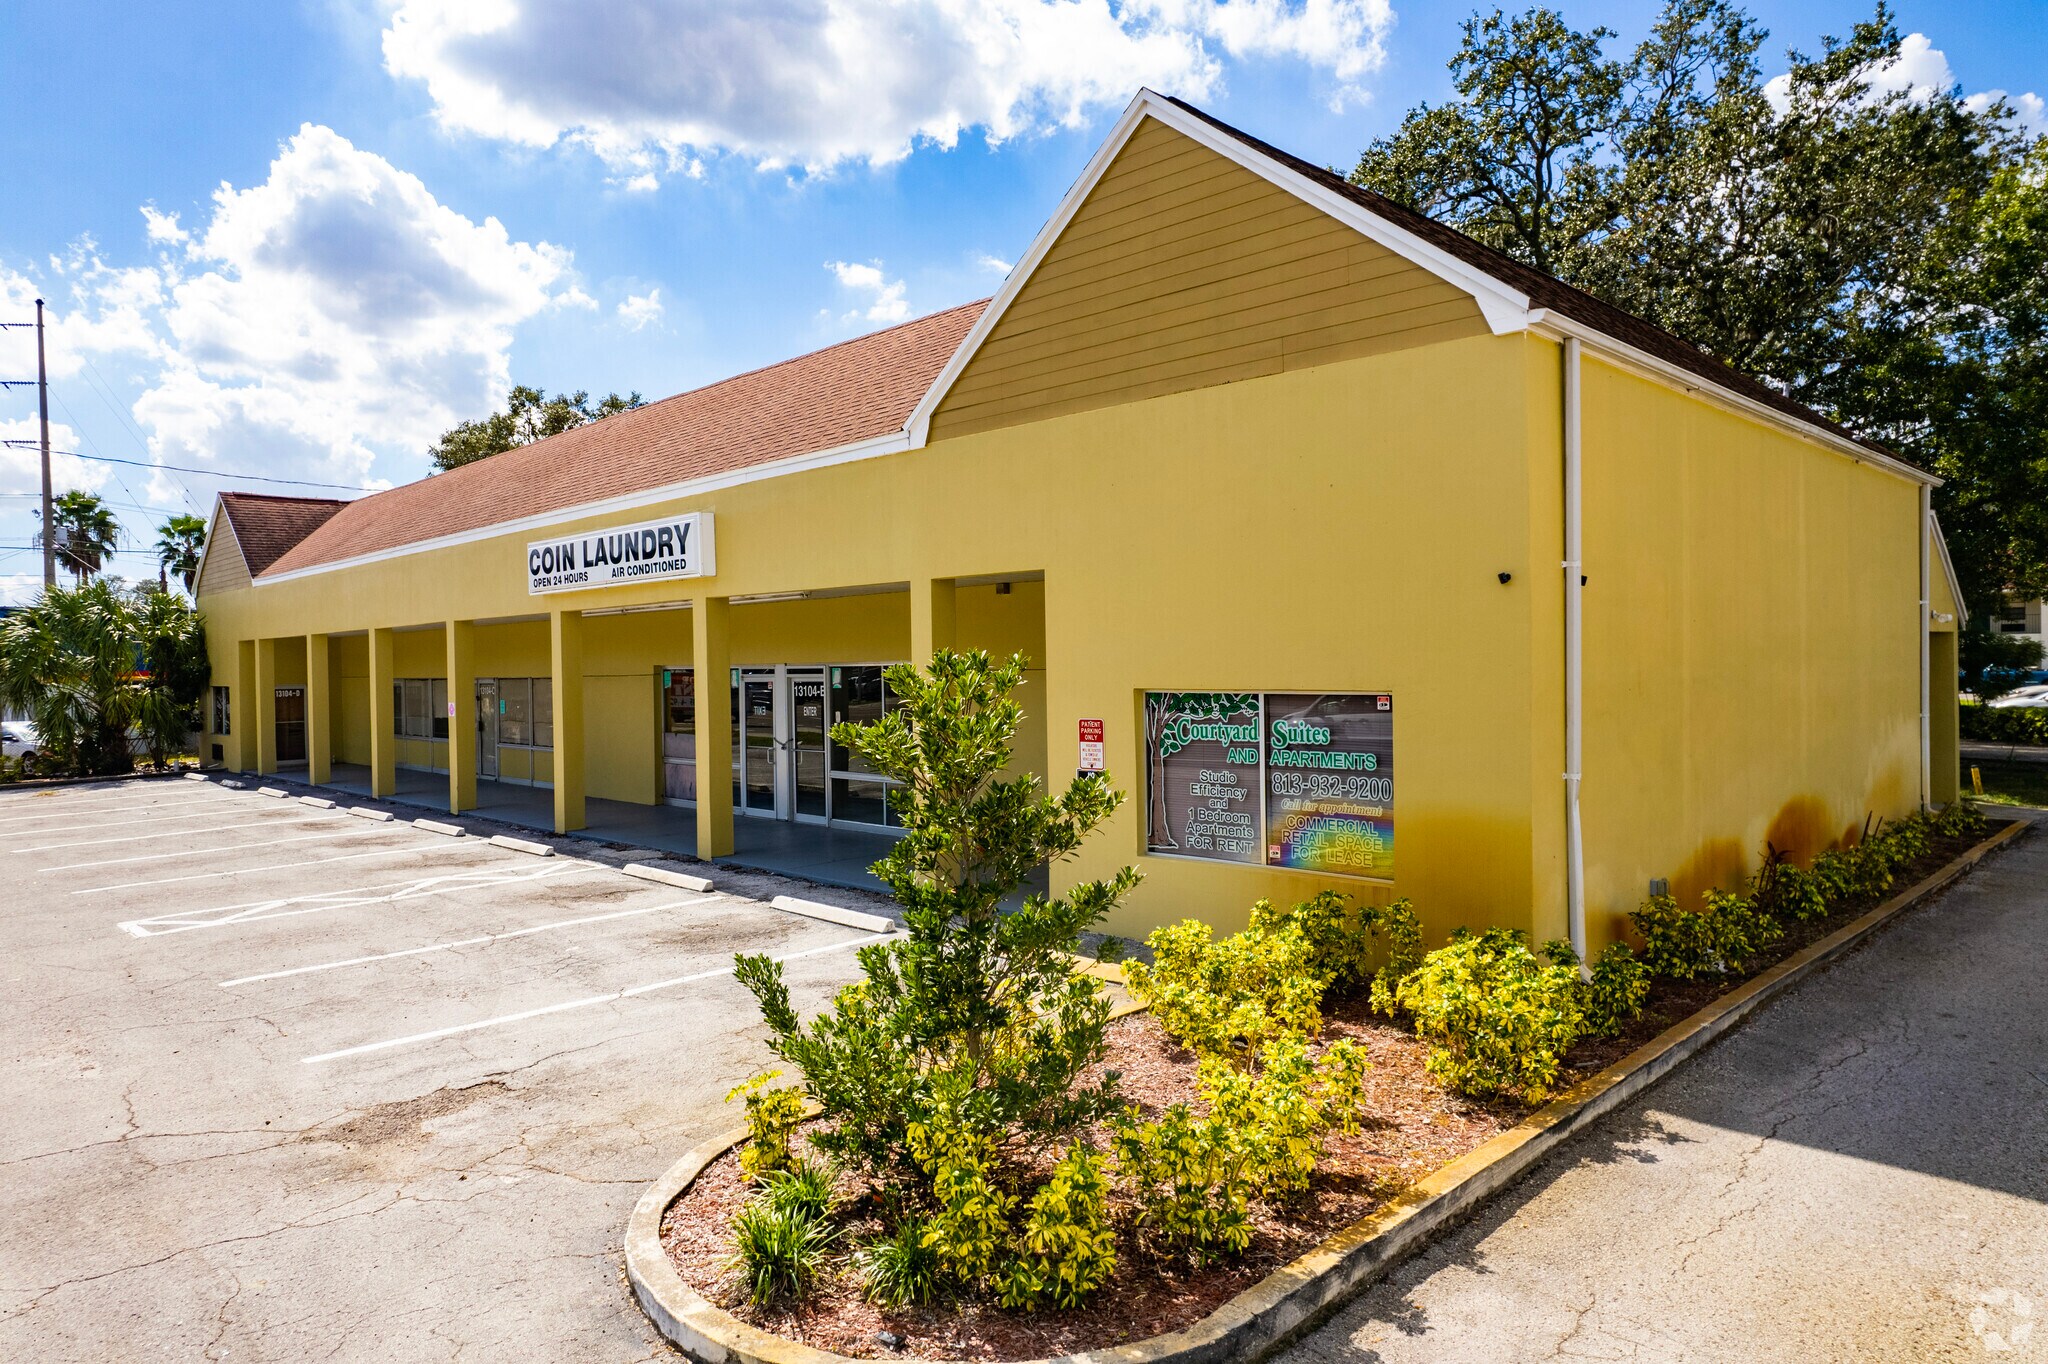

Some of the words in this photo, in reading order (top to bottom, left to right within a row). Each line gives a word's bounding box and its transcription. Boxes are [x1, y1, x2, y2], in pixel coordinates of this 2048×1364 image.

[529, 543, 575, 576] COIN
[583, 523, 691, 568] LAUNDRY
[611, 567, 625, 578] AIR
[627, 558, 687, 576] CONDITIONED
[533, 575, 551, 588] OPEN
[553, 574, 562, 585] 24
[564, 572, 588, 585] HOURS
[803, 706, 817, 716] ENTER
[1175, 717, 1260, 747] Courtyard
[1271, 719, 1330, 749] Suites
[1227, 747, 1259, 765] AND
[1269, 750, 1377, 771] APARTMENTS
[1200, 769, 1237, 784] Studio
[1272, 772, 1392, 801] 813-932-9200
[1190, 782, 1247, 801] Efficiency
[1209, 798, 1228, 809] and
[1281, 798, 1301, 811] Call
[1302, 800, 1318, 811] for
[1319, 801, 1383, 817] appointment
[1188, 807, 1194, 819] 1
[1198, 808, 1251, 824] Bedroom
[1286, 814, 1378, 836] COMMERCIAL
[1186, 820, 1254, 838] Apartments
[1186, 834, 1213, 850] FOR
[1217, 838, 1254, 854] RENT
[1281, 830, 1329, 847] RETAIL
[1336, 834, 1383, 852] SPACE
[1291, 845, 1321, 861] FOR
[1326, 848, 1373, 867] LEASE
